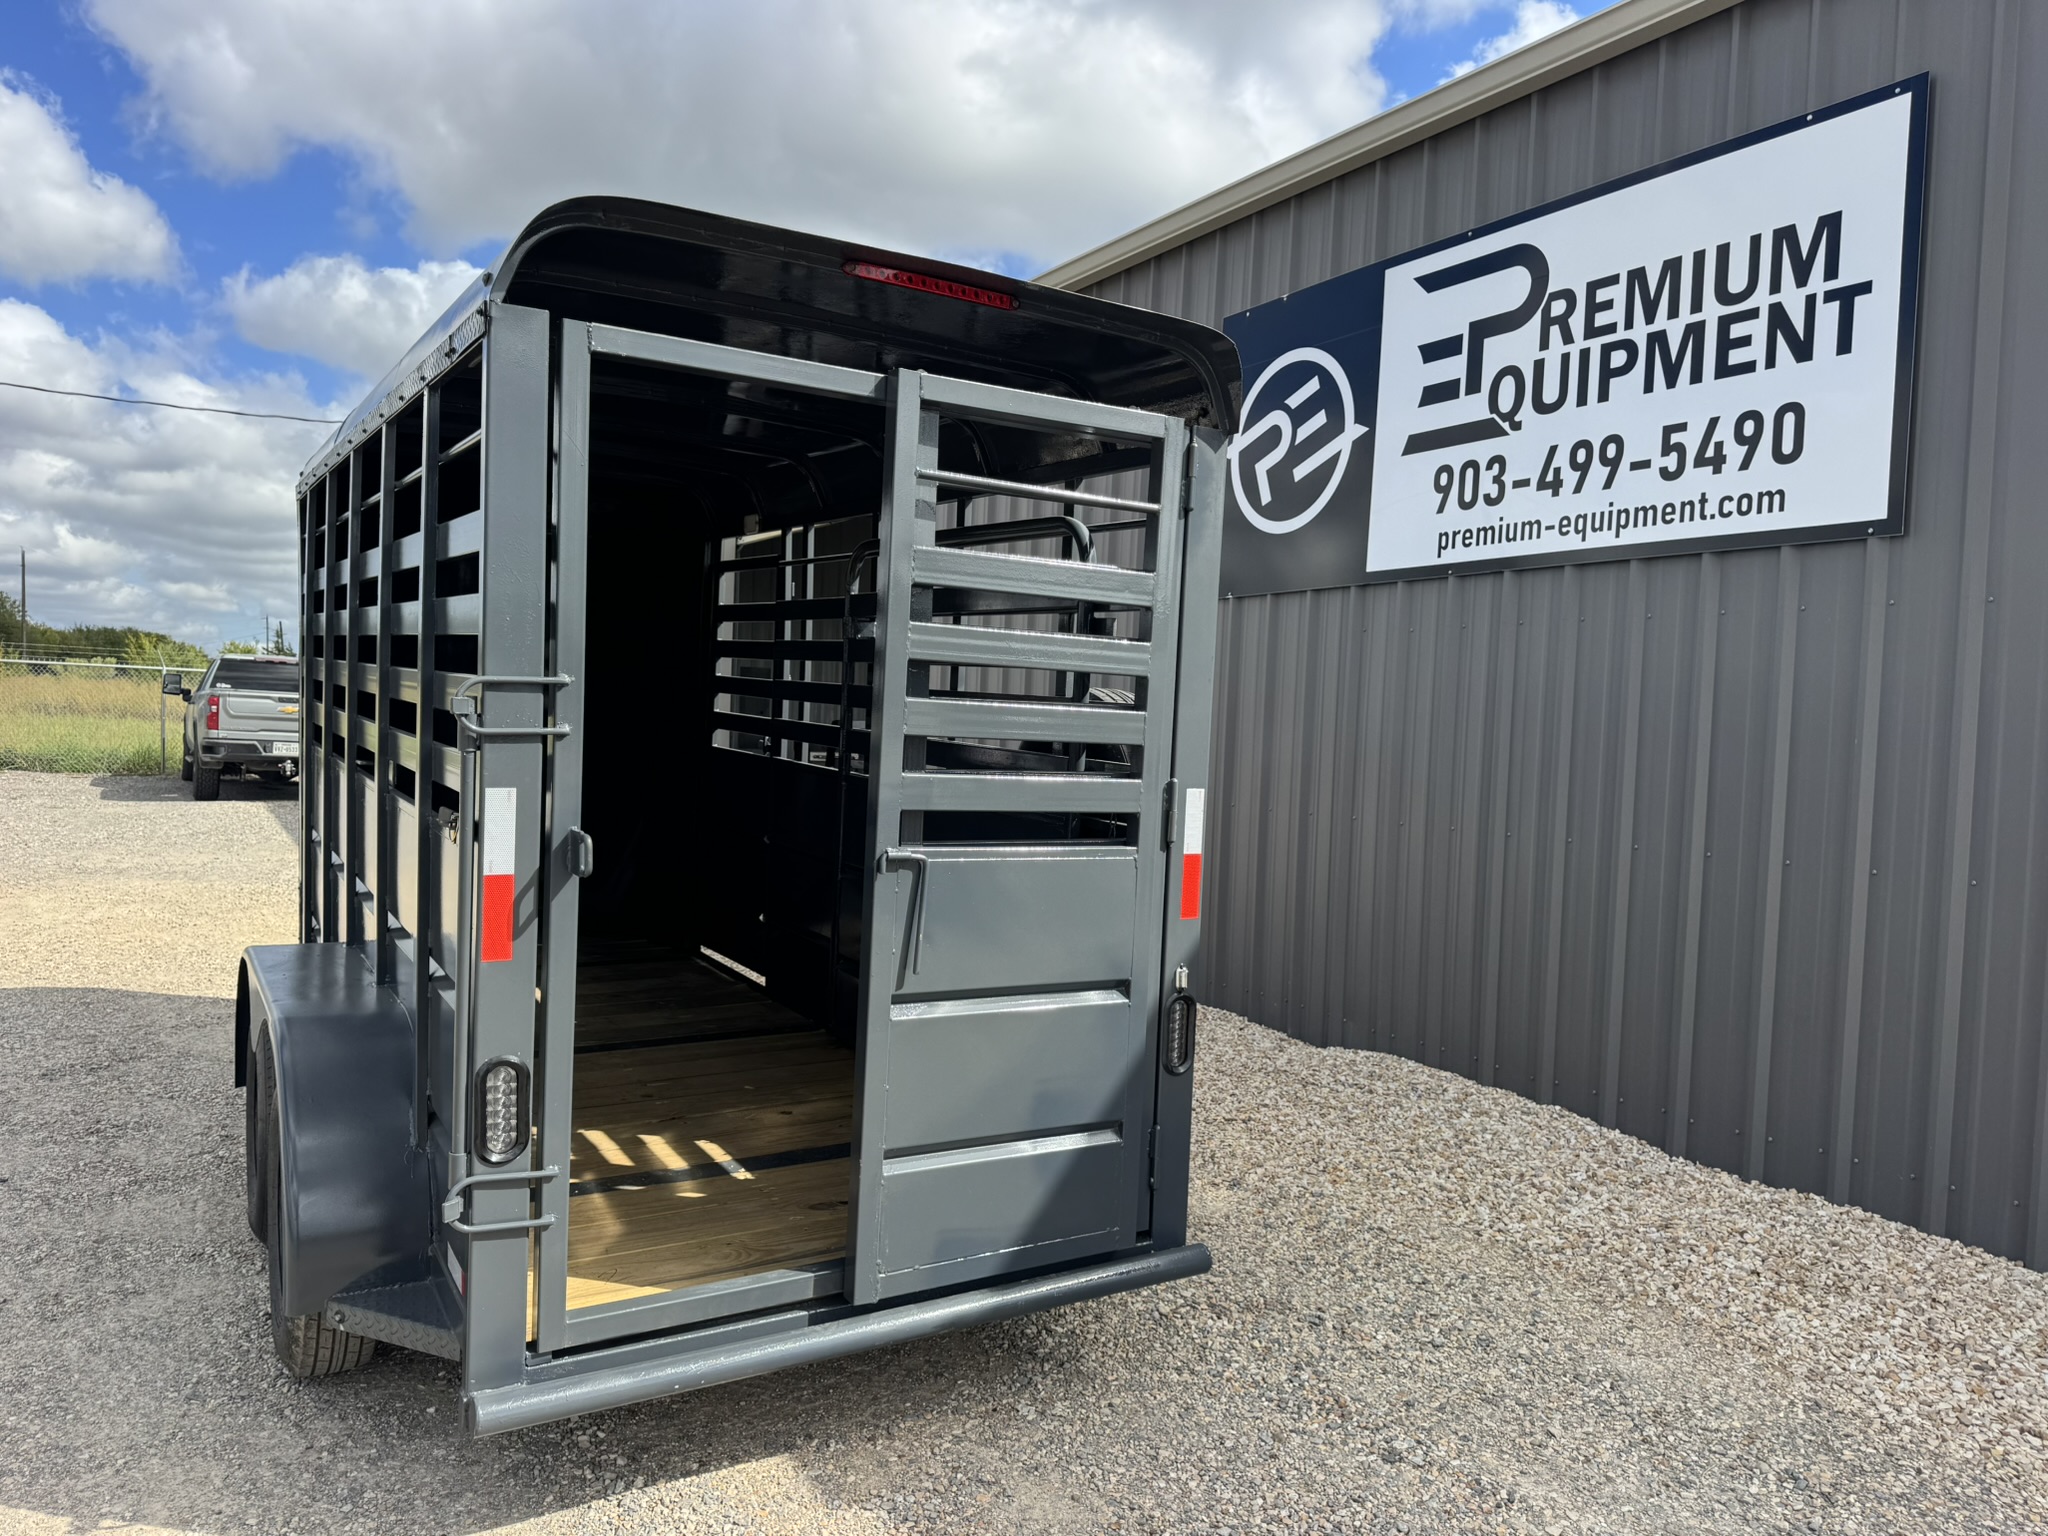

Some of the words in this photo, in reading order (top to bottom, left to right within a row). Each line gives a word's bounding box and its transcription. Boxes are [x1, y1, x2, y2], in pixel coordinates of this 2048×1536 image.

[1401, 279, 1874, 458] EQUIPMENT
[1414, 210, 1843, 396] PREMIUM
[1433, 401, 1806, 515] 903-499-5490
[1437, 488, 1787, 558] premium-equipment.com
